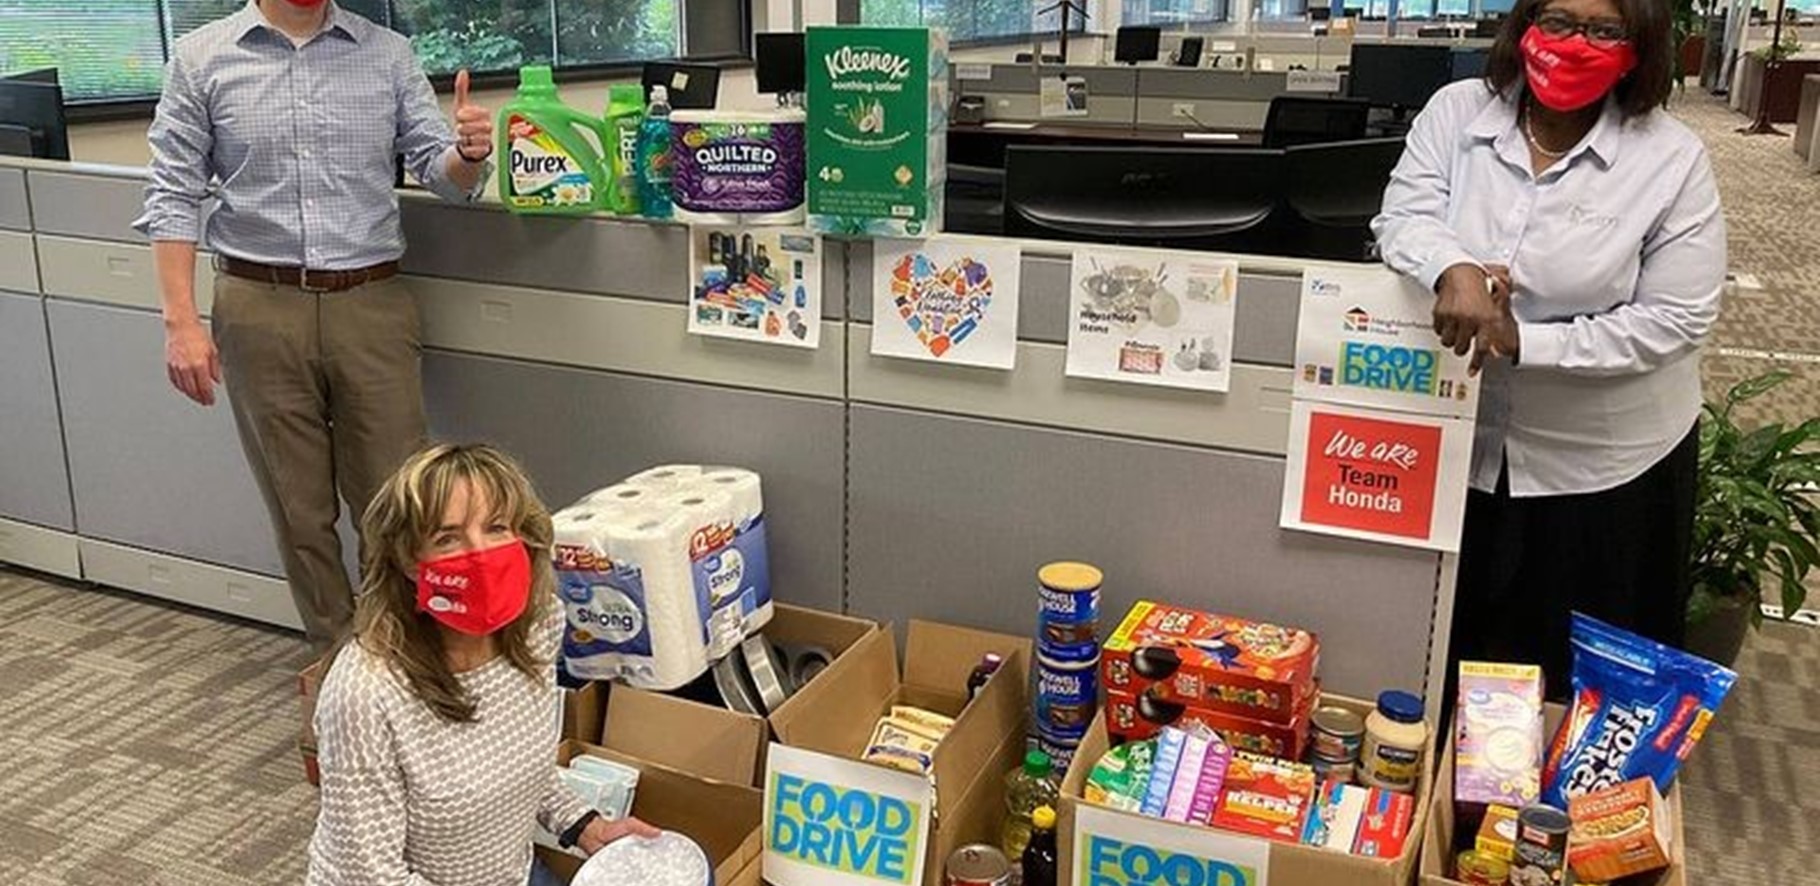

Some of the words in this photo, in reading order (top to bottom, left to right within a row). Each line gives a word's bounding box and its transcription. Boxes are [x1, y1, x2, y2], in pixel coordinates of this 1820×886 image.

[824, 46, 910, 80] Kleenex
[511, 150, 567, 174] Purex
[620, 126, 637, 175] PERT
[695, 145, 777, 164] QUILTED
[707, 163, 766, 173] NORTHERN
[819, 166, 830, 181] 4
[1345, 341, 1434, 371] FOOD
[1344, 364, 1432, 393] DRIVE
[1324, 430, 1365, 459] We
[1338, 463, 1398, 490] Team
[1328, 484, 1403, 513] Honda
[711, 565, 741, 588] Strong
[577, 607, 633, 632] Strong
[776, 772, 911, 837] FOOD
[1227, 790, 1298, 816] HELPER
[772, 813, 908, 880] DRIVE
[1090, 835, 1246, 886] FOOD
